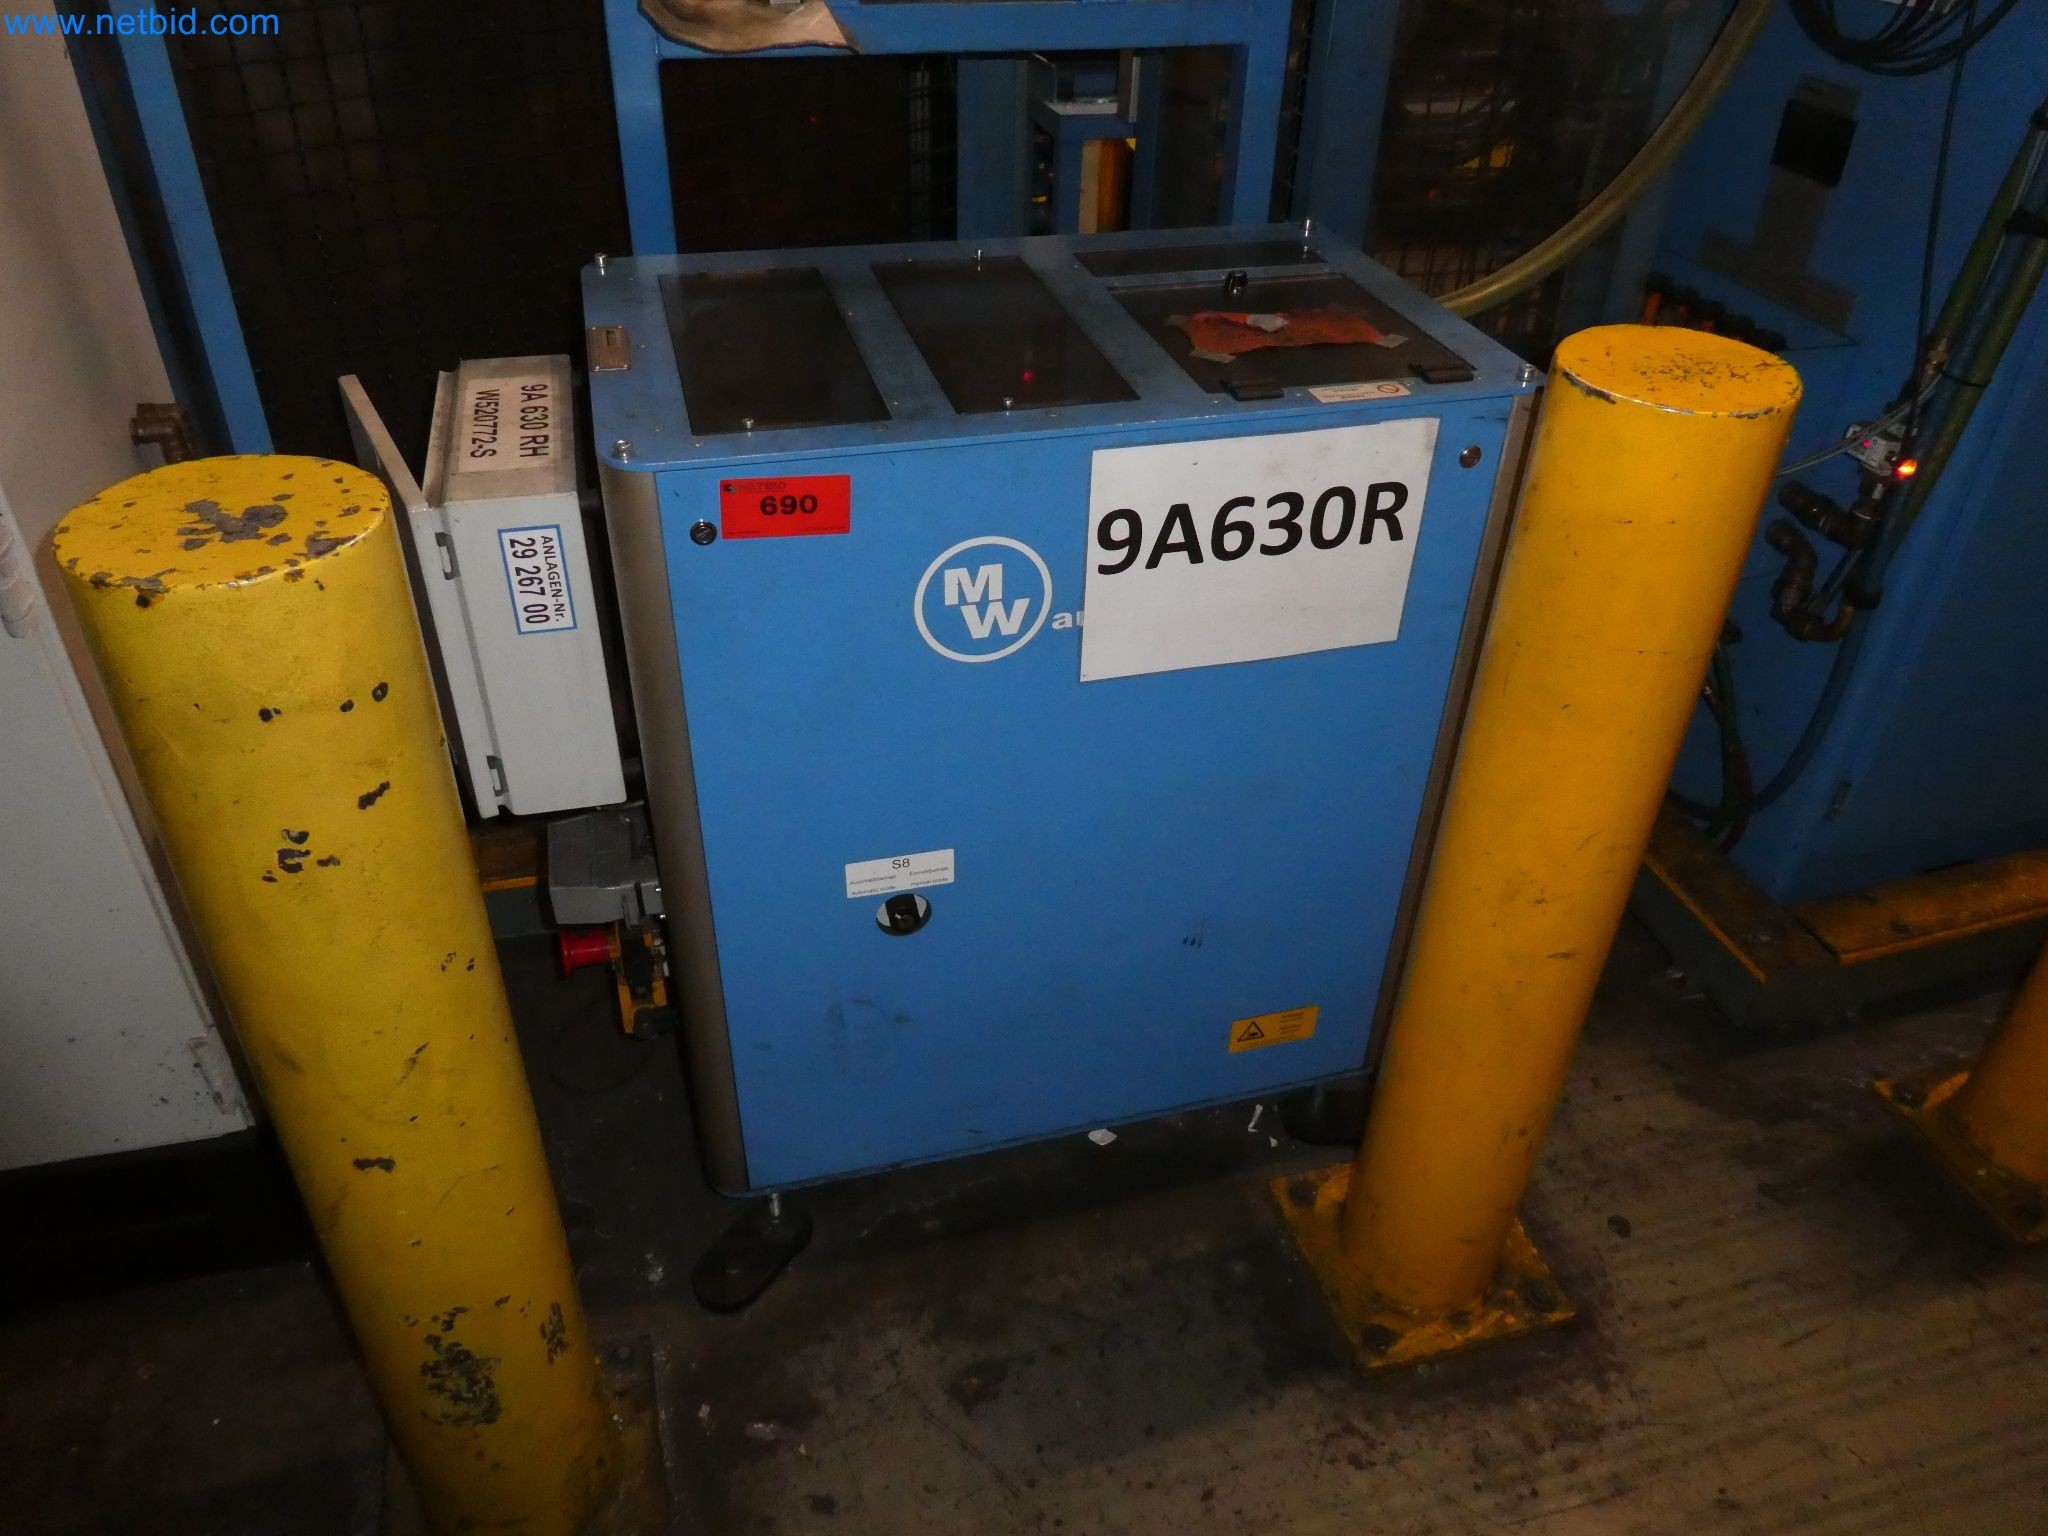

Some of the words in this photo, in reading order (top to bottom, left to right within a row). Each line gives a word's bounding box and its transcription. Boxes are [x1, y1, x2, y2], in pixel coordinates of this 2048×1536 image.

[520, 383, 549, 403] 9A
[470, 389, 500, 458] W520772-S
[519, 405, 549, 431] 630
[519, 434, 550, 458] RH
[760, 494, 818, 516] 690
[1096, 481, 1409, 576] 9A630R
[509, 537, 538, 559] 29
[514, 565, 546, 596] 267
[540, 535, 567, 622] ANLAGEN-Nr.
[523, 603, 551, 624] 00
[892, 858, 910, 870] S8
